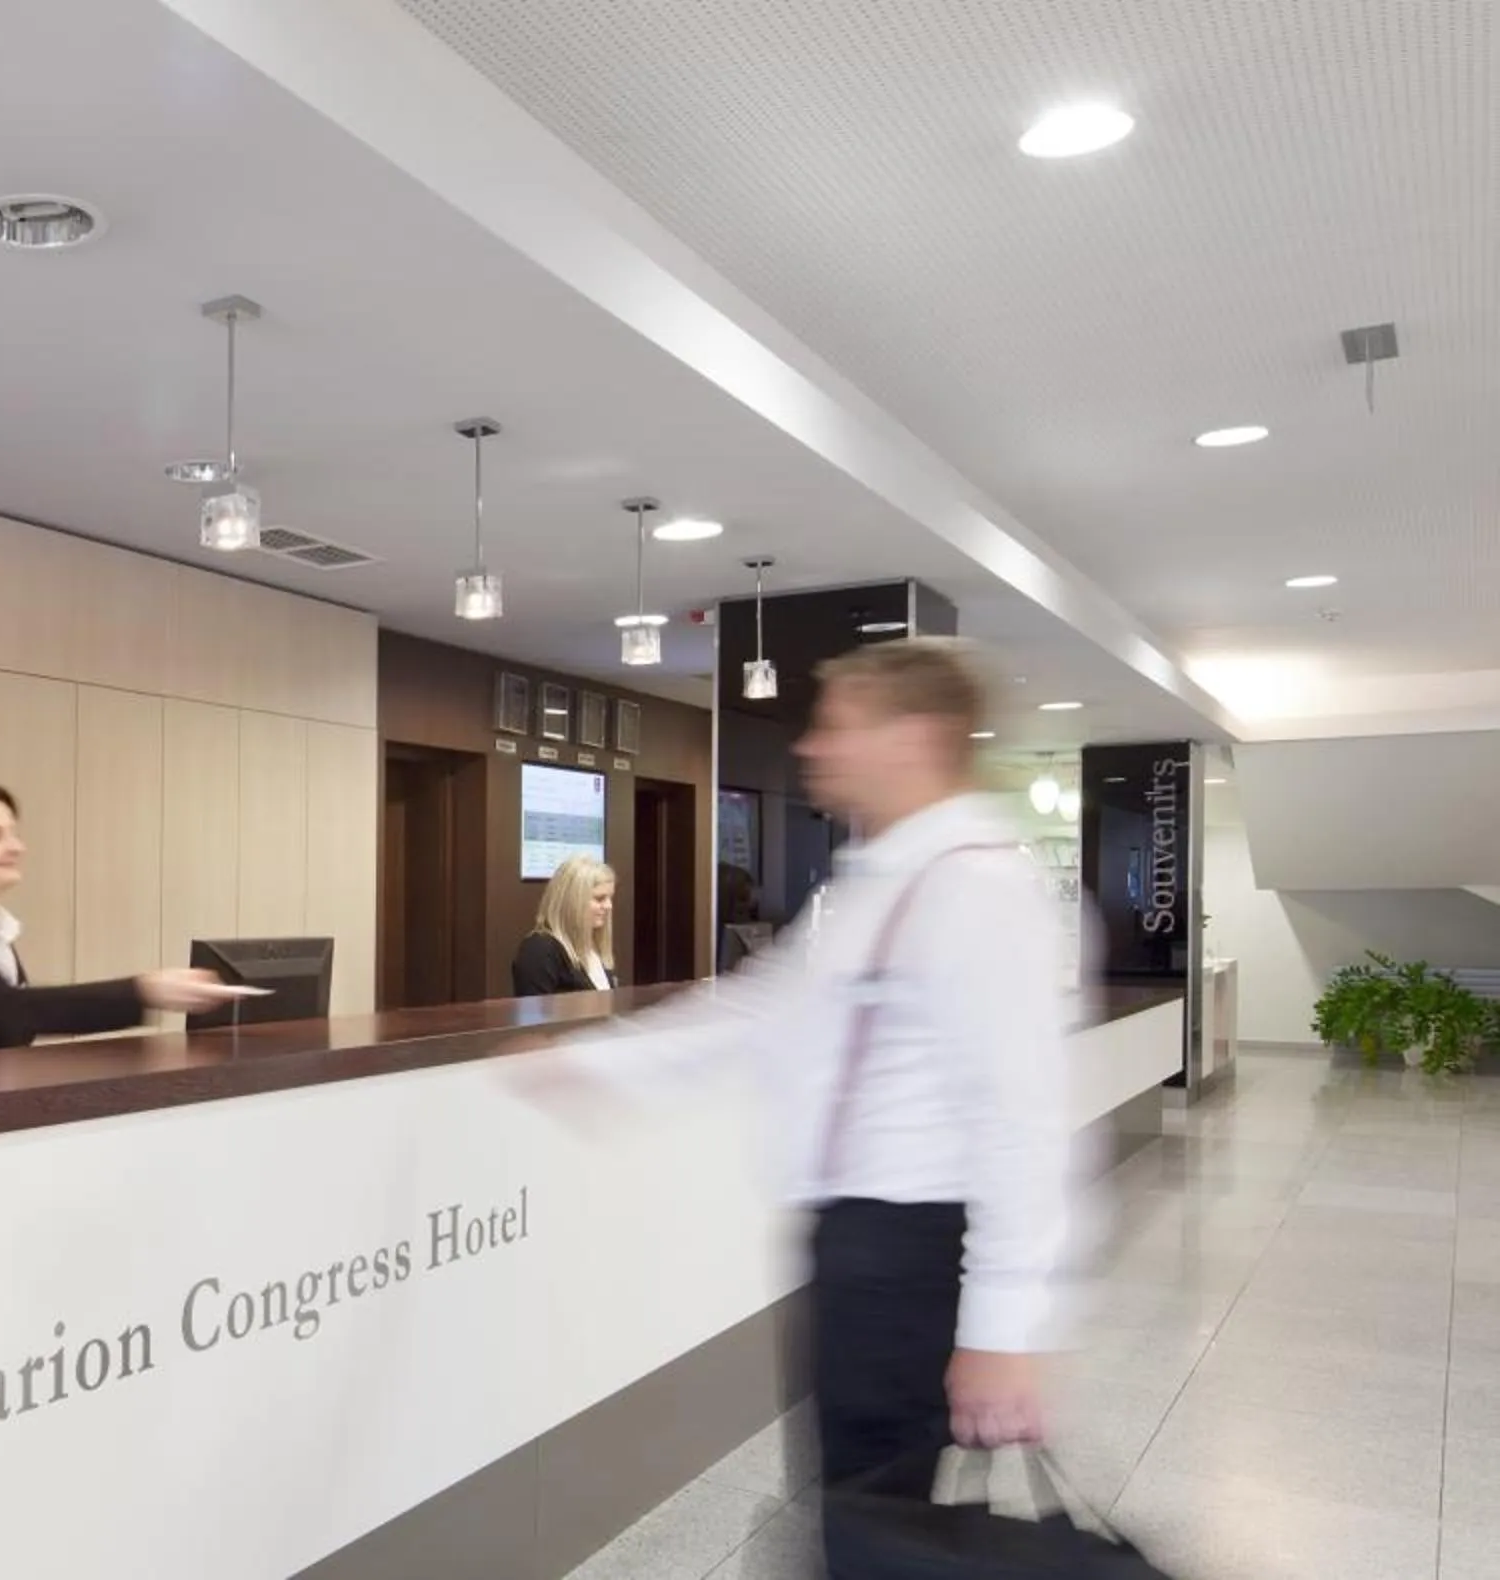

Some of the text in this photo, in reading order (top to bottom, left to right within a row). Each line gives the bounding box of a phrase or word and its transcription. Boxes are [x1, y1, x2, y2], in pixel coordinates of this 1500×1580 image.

[1143, 758, 1176, 933] Souvenirs
[180, 1239, 412, 1352] Congress
[425, 1186, 530, 1270] Hotel
